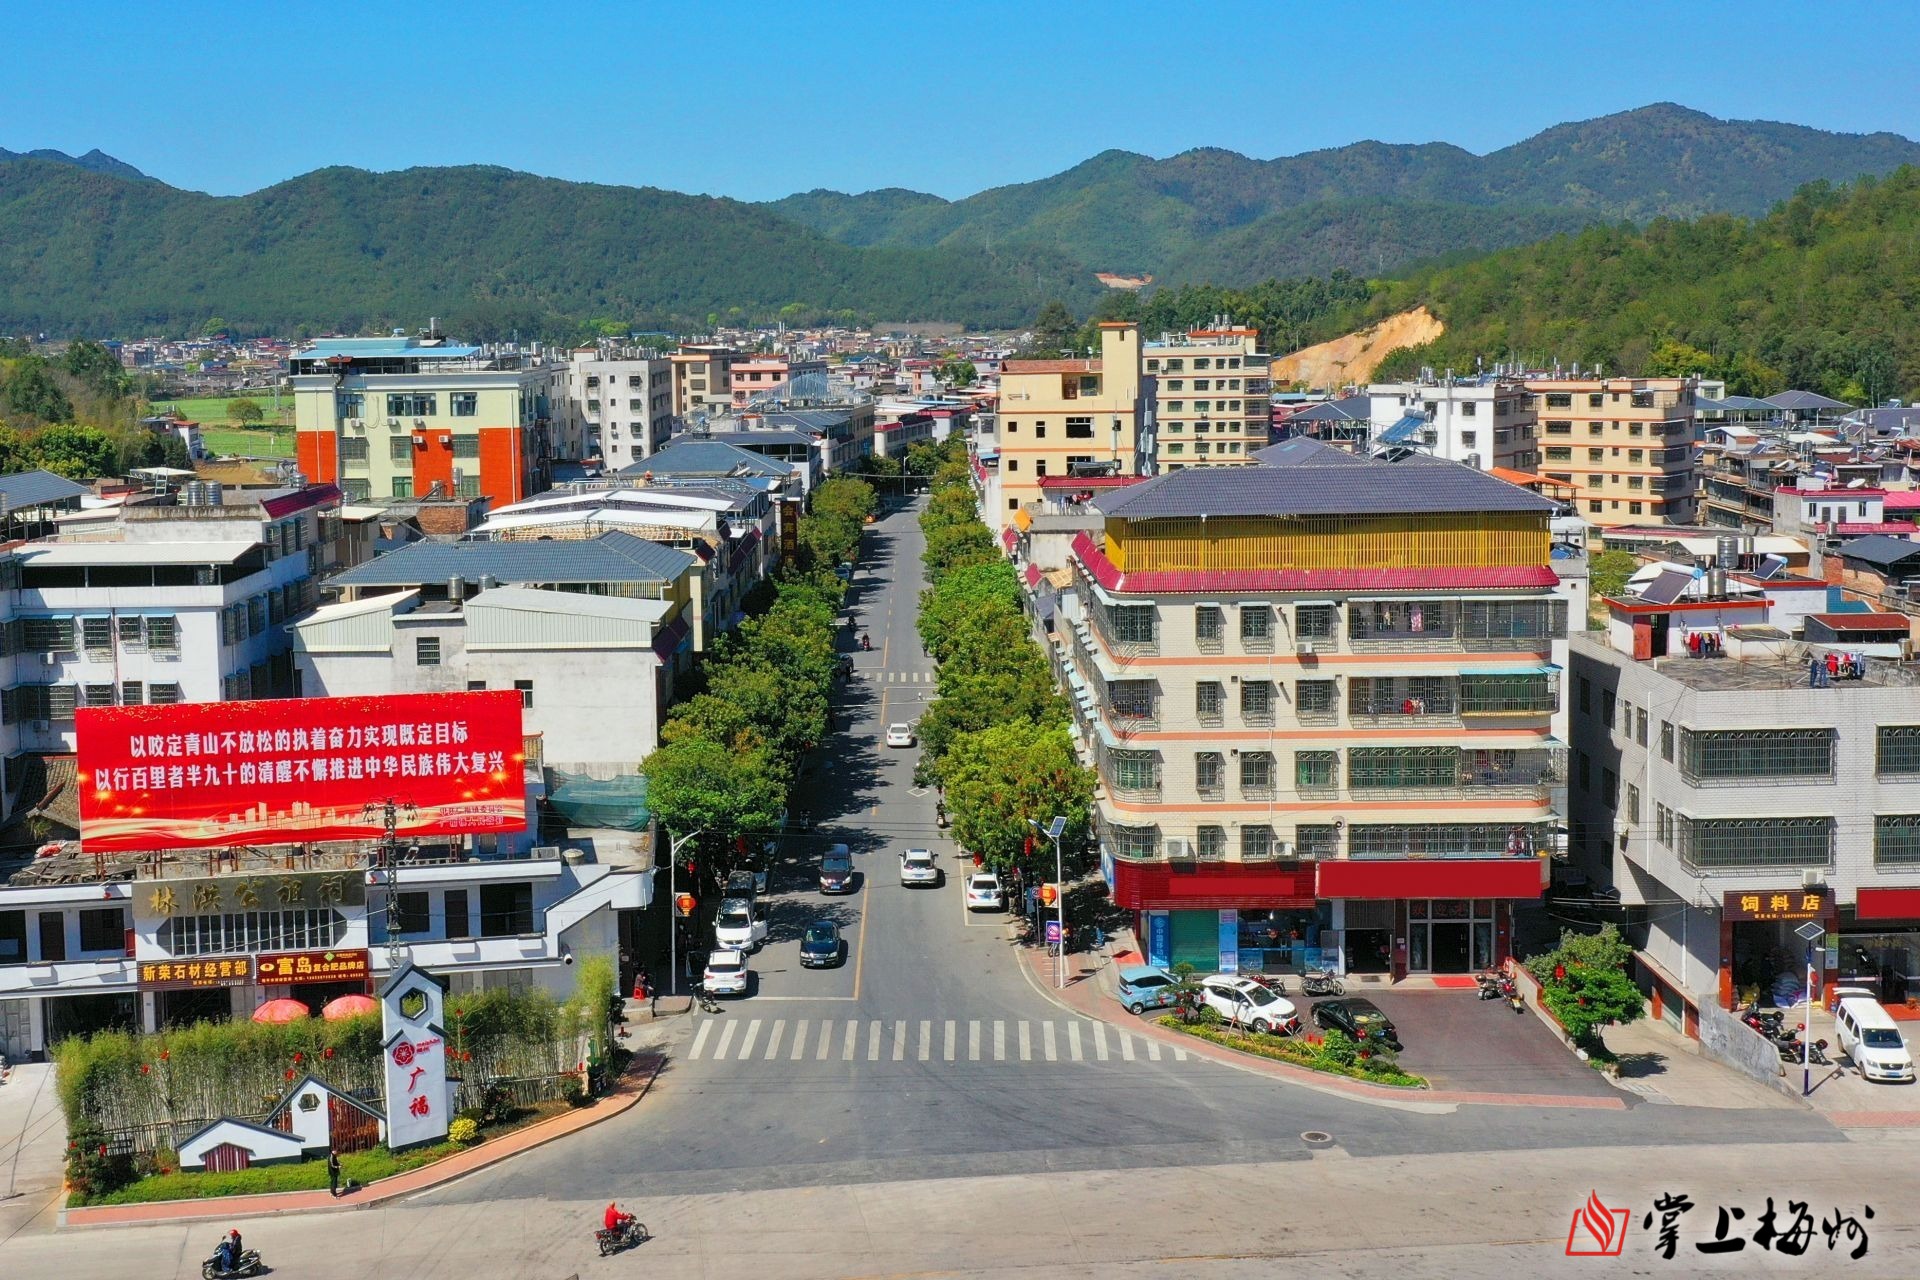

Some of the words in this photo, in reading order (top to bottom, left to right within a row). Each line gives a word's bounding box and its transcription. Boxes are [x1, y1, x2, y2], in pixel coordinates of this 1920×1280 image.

[130, 720, 468, 758] 以咬定青山不放松的执着奋力实现既定目标
[95, 750, 504, 792] 以行百里者半九十的清醒不懈推进中华民族伟大复兴
[1741, 895, 1820, 911] 饲料店
[142, 959, 247, 982] 新荣石材经营部
[276, 957, 312, 976] 富岛
[408, 1066, 429, 1117] 广福
